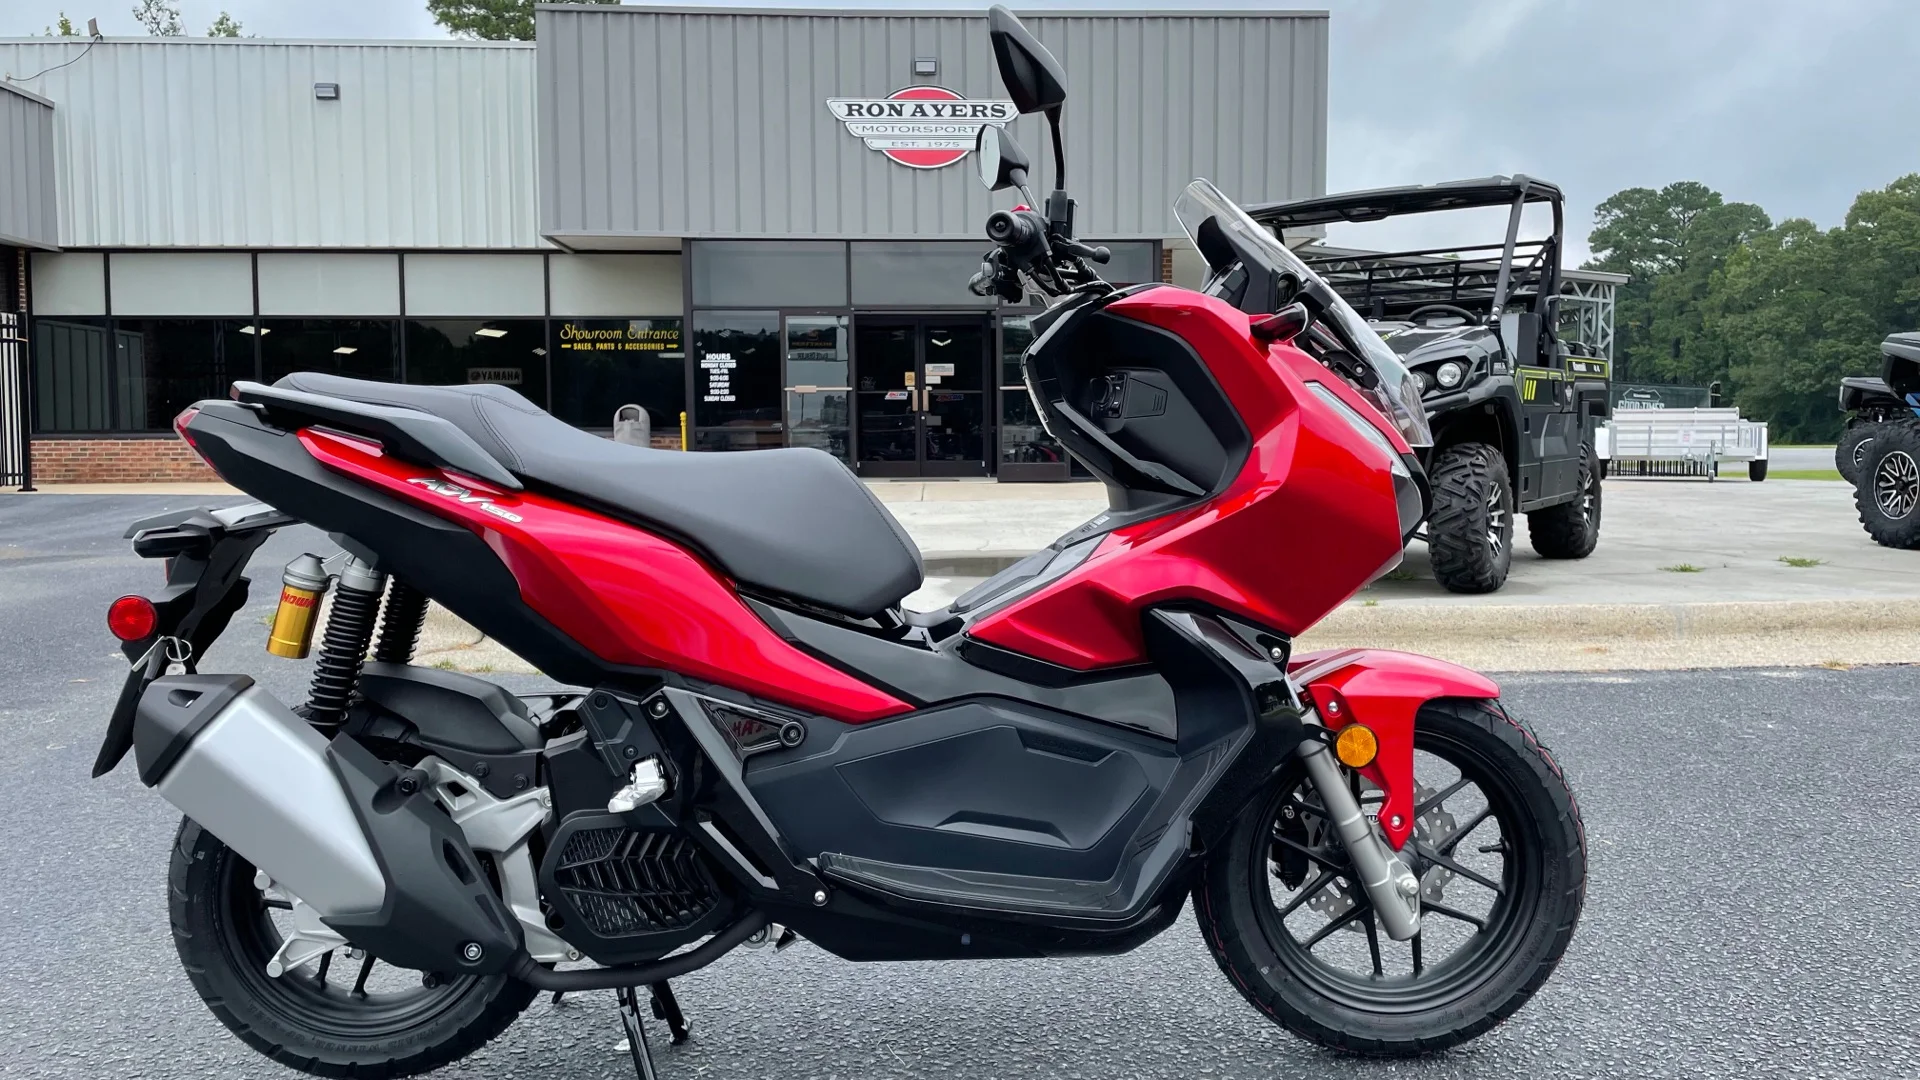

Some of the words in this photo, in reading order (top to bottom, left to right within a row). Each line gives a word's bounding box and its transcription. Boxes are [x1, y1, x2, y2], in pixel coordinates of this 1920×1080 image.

[845, 103, 905, 117] RON
[910, 103, 1007, 118] AYERS
[862, 125, 981, 133] MOTORSPORT
[560, 324, 622, 340] Showroom
[627, 325, 679, 339] Entrance
[481, 371, 520, 381] YAMAHA
